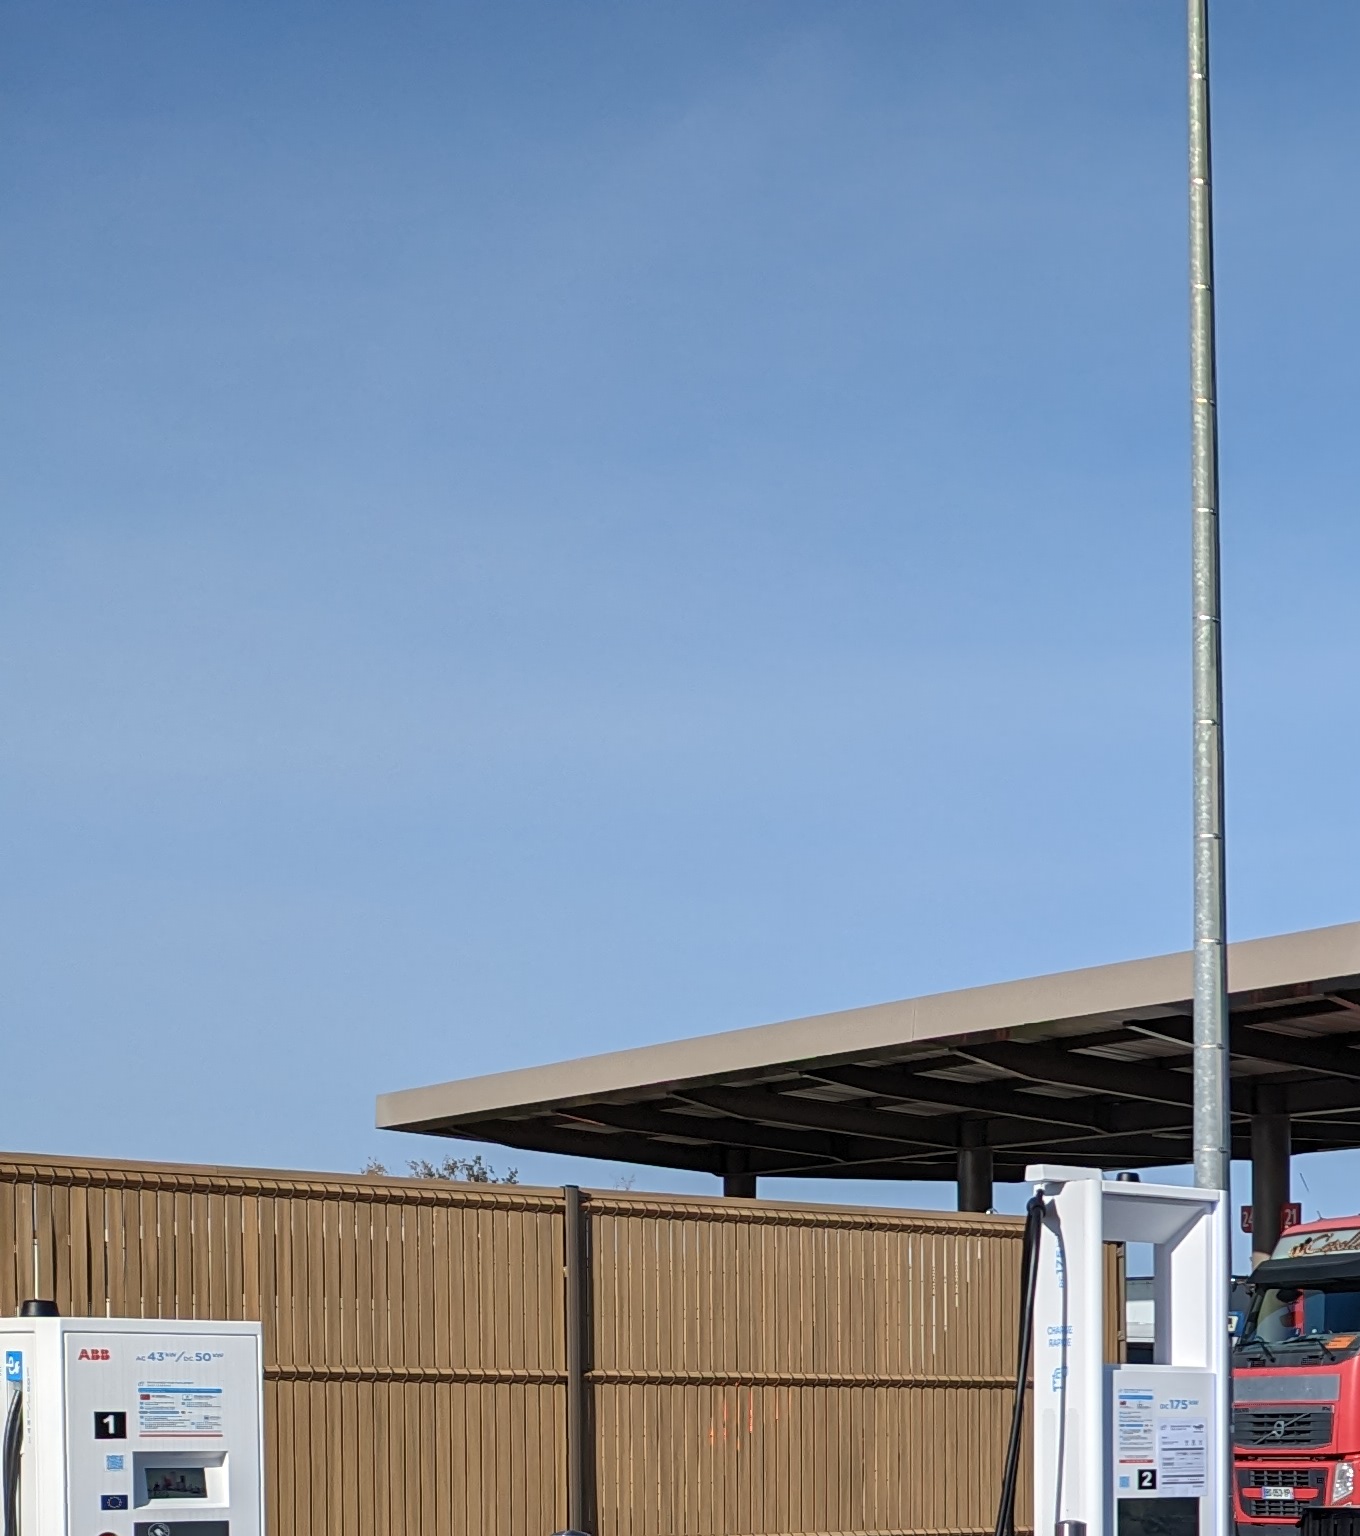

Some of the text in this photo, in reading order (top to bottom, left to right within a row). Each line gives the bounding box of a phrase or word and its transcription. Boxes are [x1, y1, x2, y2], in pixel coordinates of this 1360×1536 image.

[1285, 1208, 1297, 1225] 21
[78, 1349, 111, 1361] ABB
[102, 1414, 115, 1435] 1
[1141, 1471, 1153, 1487] 2
